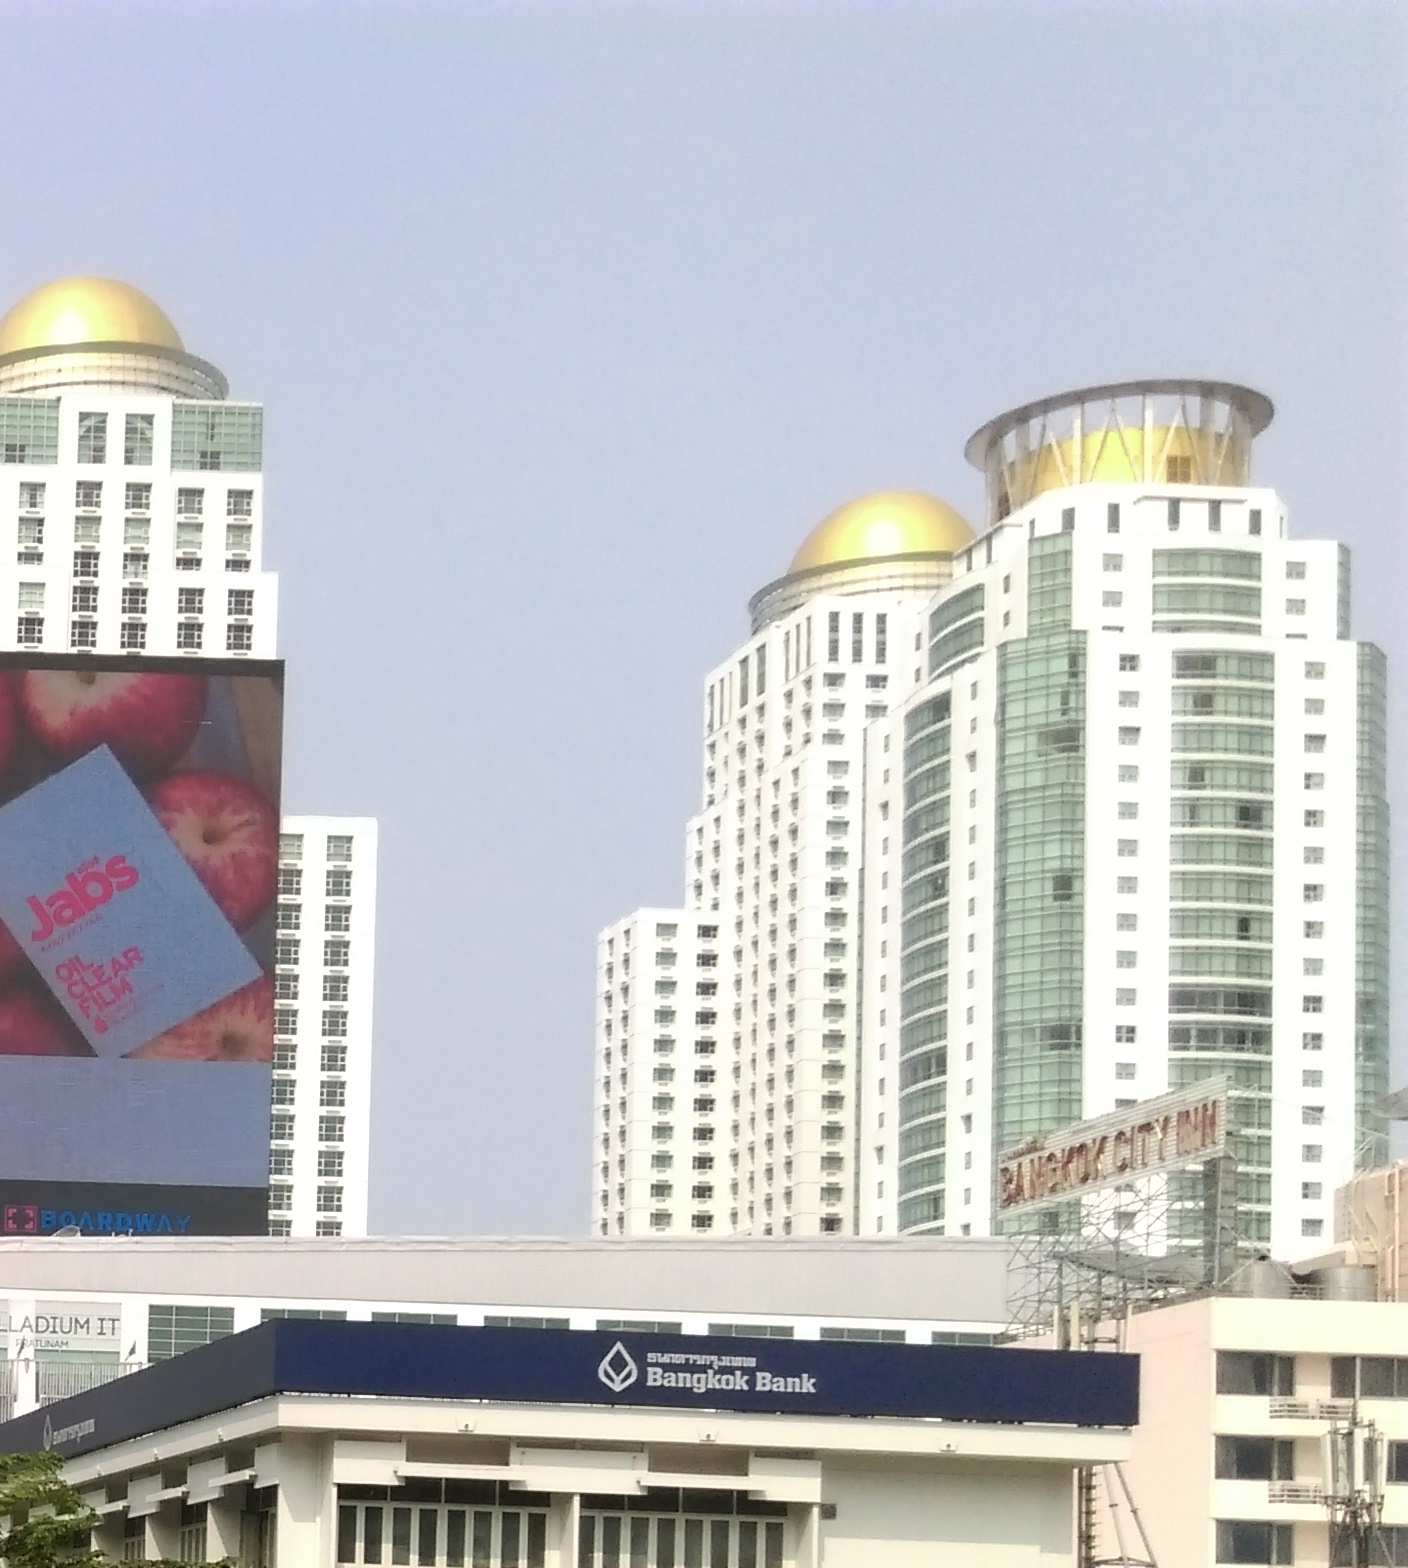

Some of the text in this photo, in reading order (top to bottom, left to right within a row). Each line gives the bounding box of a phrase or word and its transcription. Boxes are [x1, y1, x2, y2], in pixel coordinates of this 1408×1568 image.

[27, 855, 140, 942] Jabs
[1114, 1115, 1171, 1172] CITY
[1176, 1100, 1217, 1155] INN
[97, 1317, 121, 1337] IT
[646, 1366, 817, 1393] Bangkok Bank
